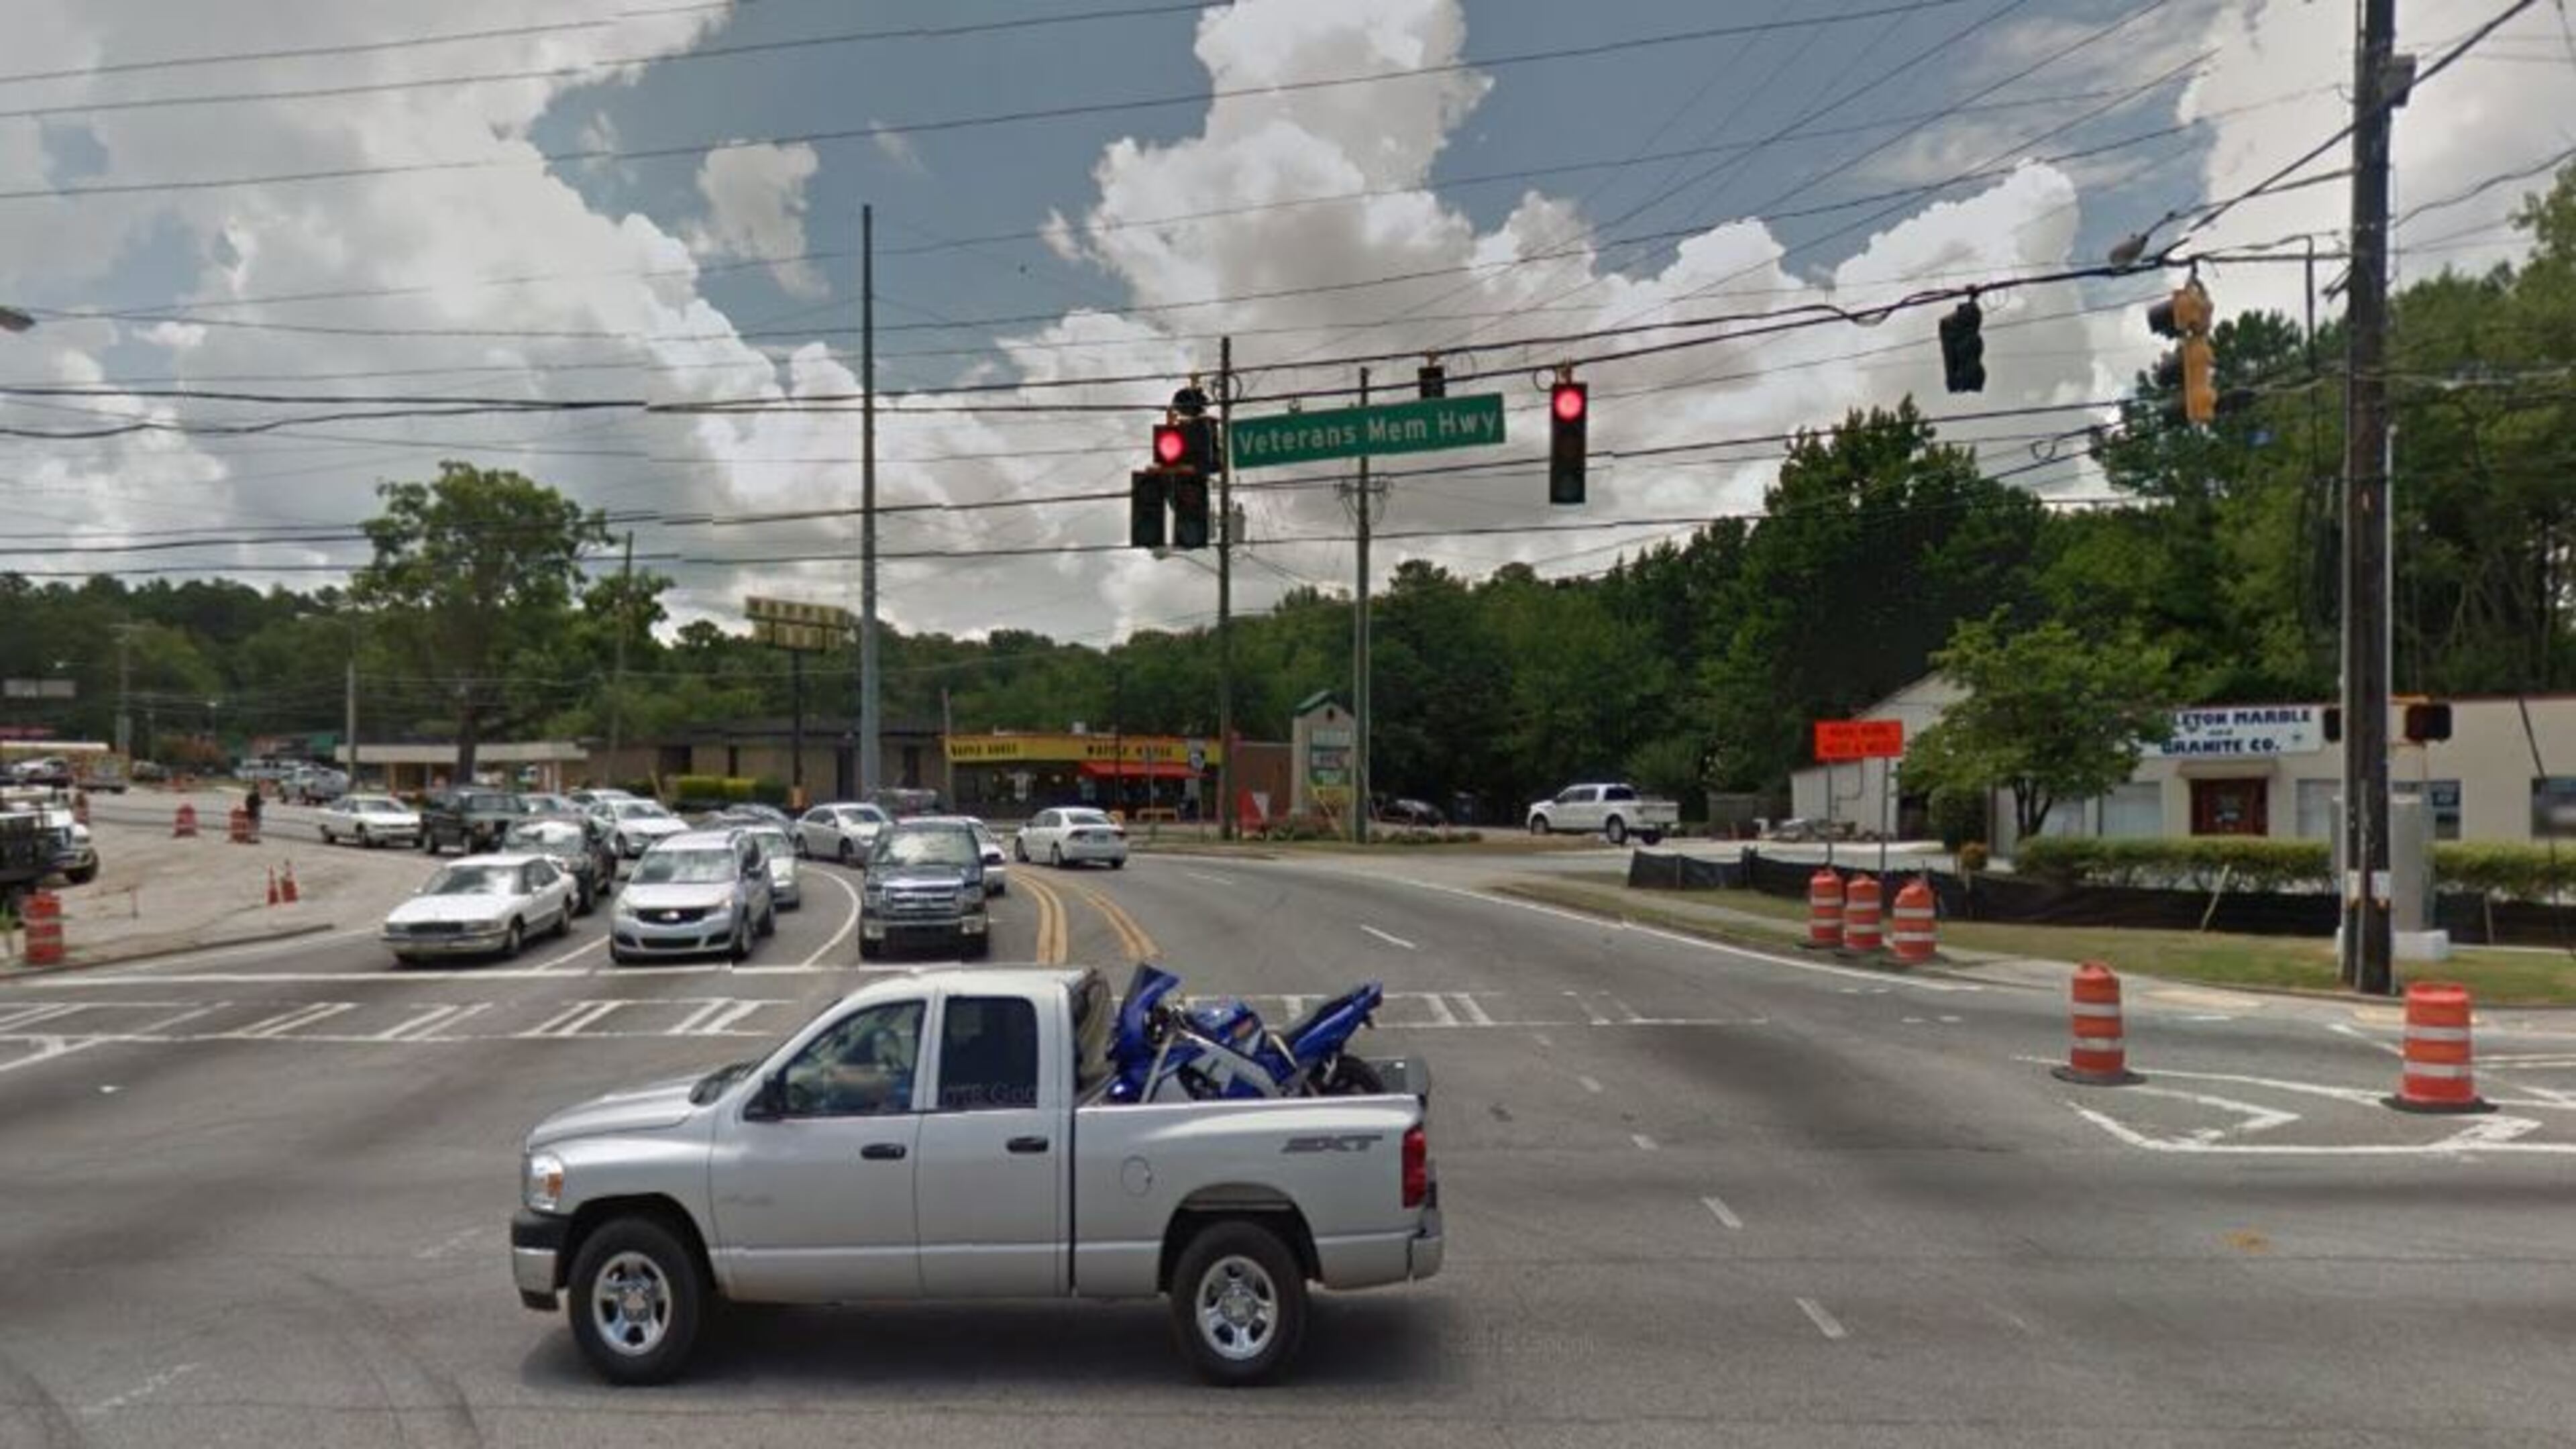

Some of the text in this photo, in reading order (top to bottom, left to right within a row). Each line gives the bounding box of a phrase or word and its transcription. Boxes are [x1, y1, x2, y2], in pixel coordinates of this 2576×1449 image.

[1238, 410, 1497, 454] Veterans Mem Hwy
[2161, 710, 2311, 726] LETON MARBLE
[2161, 737, 2280, 755] GRANITE CO.
